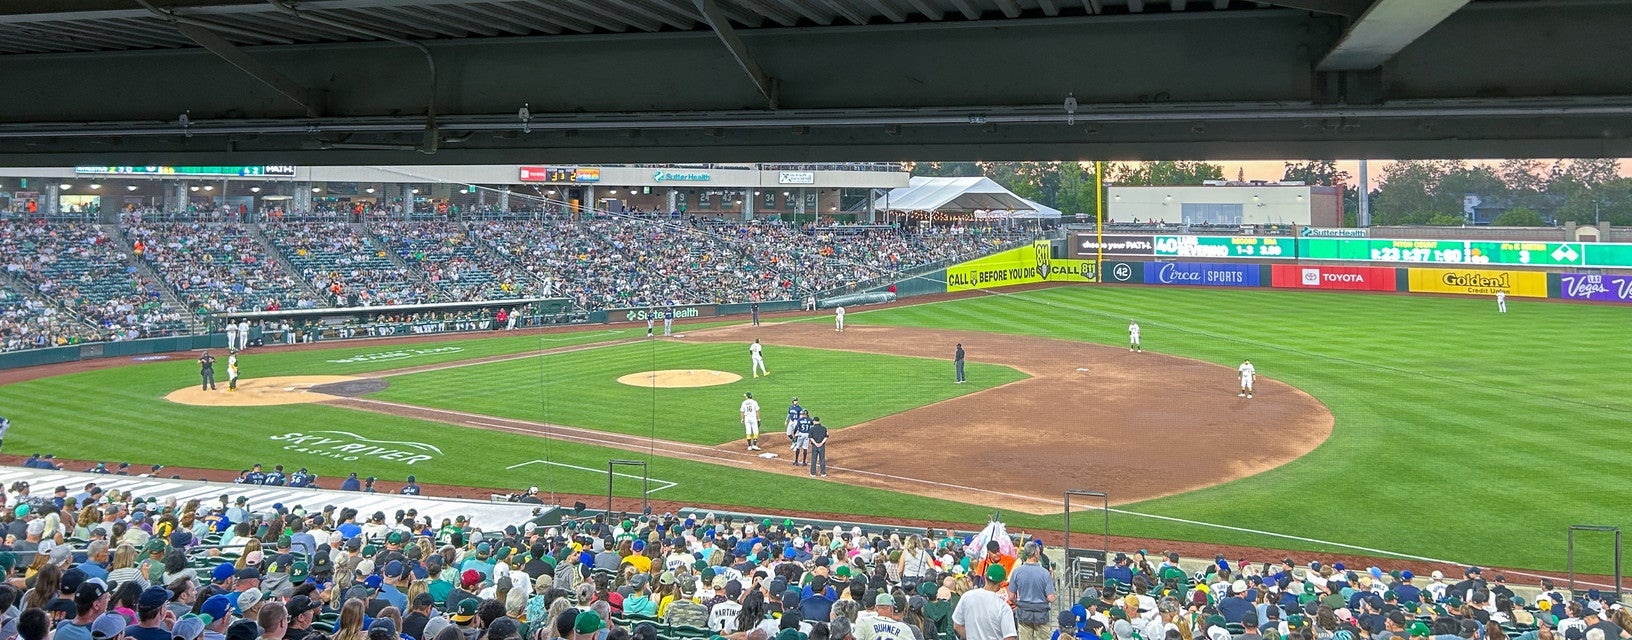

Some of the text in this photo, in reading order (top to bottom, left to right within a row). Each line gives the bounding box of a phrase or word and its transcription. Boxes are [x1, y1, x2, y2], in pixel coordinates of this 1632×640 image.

[666, 173, 711, 181] Sutter Health
[700, 193, 710, 202] 24
[765, 194, 775, 202] 34
[806, 194, 815, 202] 27
[1313, 229, 1366, 238] Sutter Health
[1157, 238, 1178, 253] 40
[1051, 263, 1096, 275] CALL 811
[1116, 267, 1128, 277] 42
[1159, 263, 1243, 283] Circa SPORTS
[948, 273, 969, 286] CALL
[979, 270, 1008, 283] BEFORE
[1009, 268, 1023, 280] YOU
[1024, 267, 1036, 279] DIG
[1322, 273, 1364, 282] TOYOTA
[1562, 275, 1609, 299] Vegas
[801, 424, 809, 432] 53
[270, 432, 433, 465] SKY RIVER
[283, 445, 359, 461] CASINO
[873, 623, 901, 638] BUHNER
